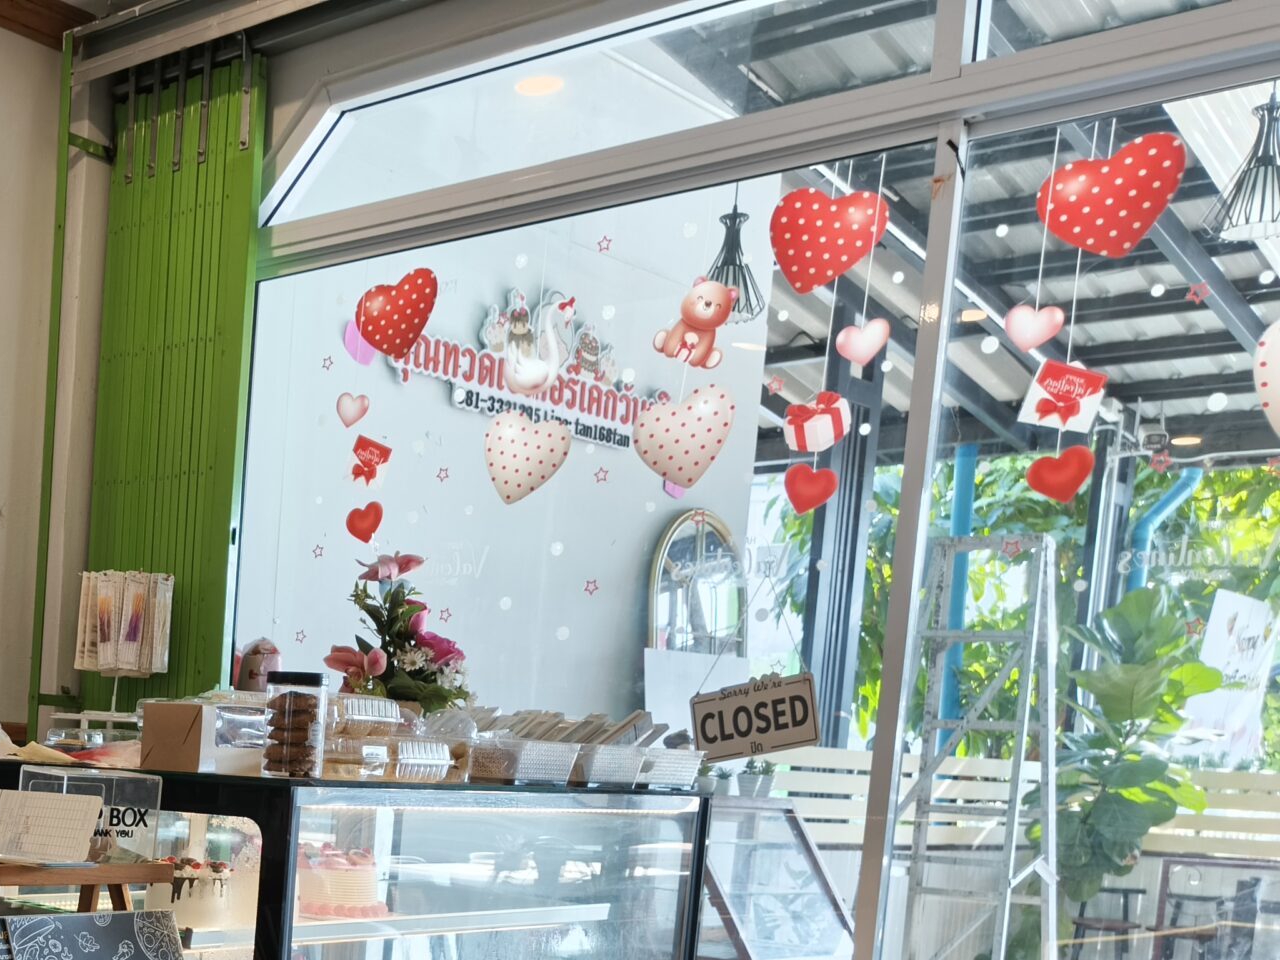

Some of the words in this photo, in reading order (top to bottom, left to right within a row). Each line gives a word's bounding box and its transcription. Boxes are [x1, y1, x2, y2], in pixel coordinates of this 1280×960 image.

[456, 388, 541, 424] 81-3321295
[575, 418, 631, 448] tan168tan
[700, 694, 809, 744] CLOSED
[109, 807, 149, 829] BOX
